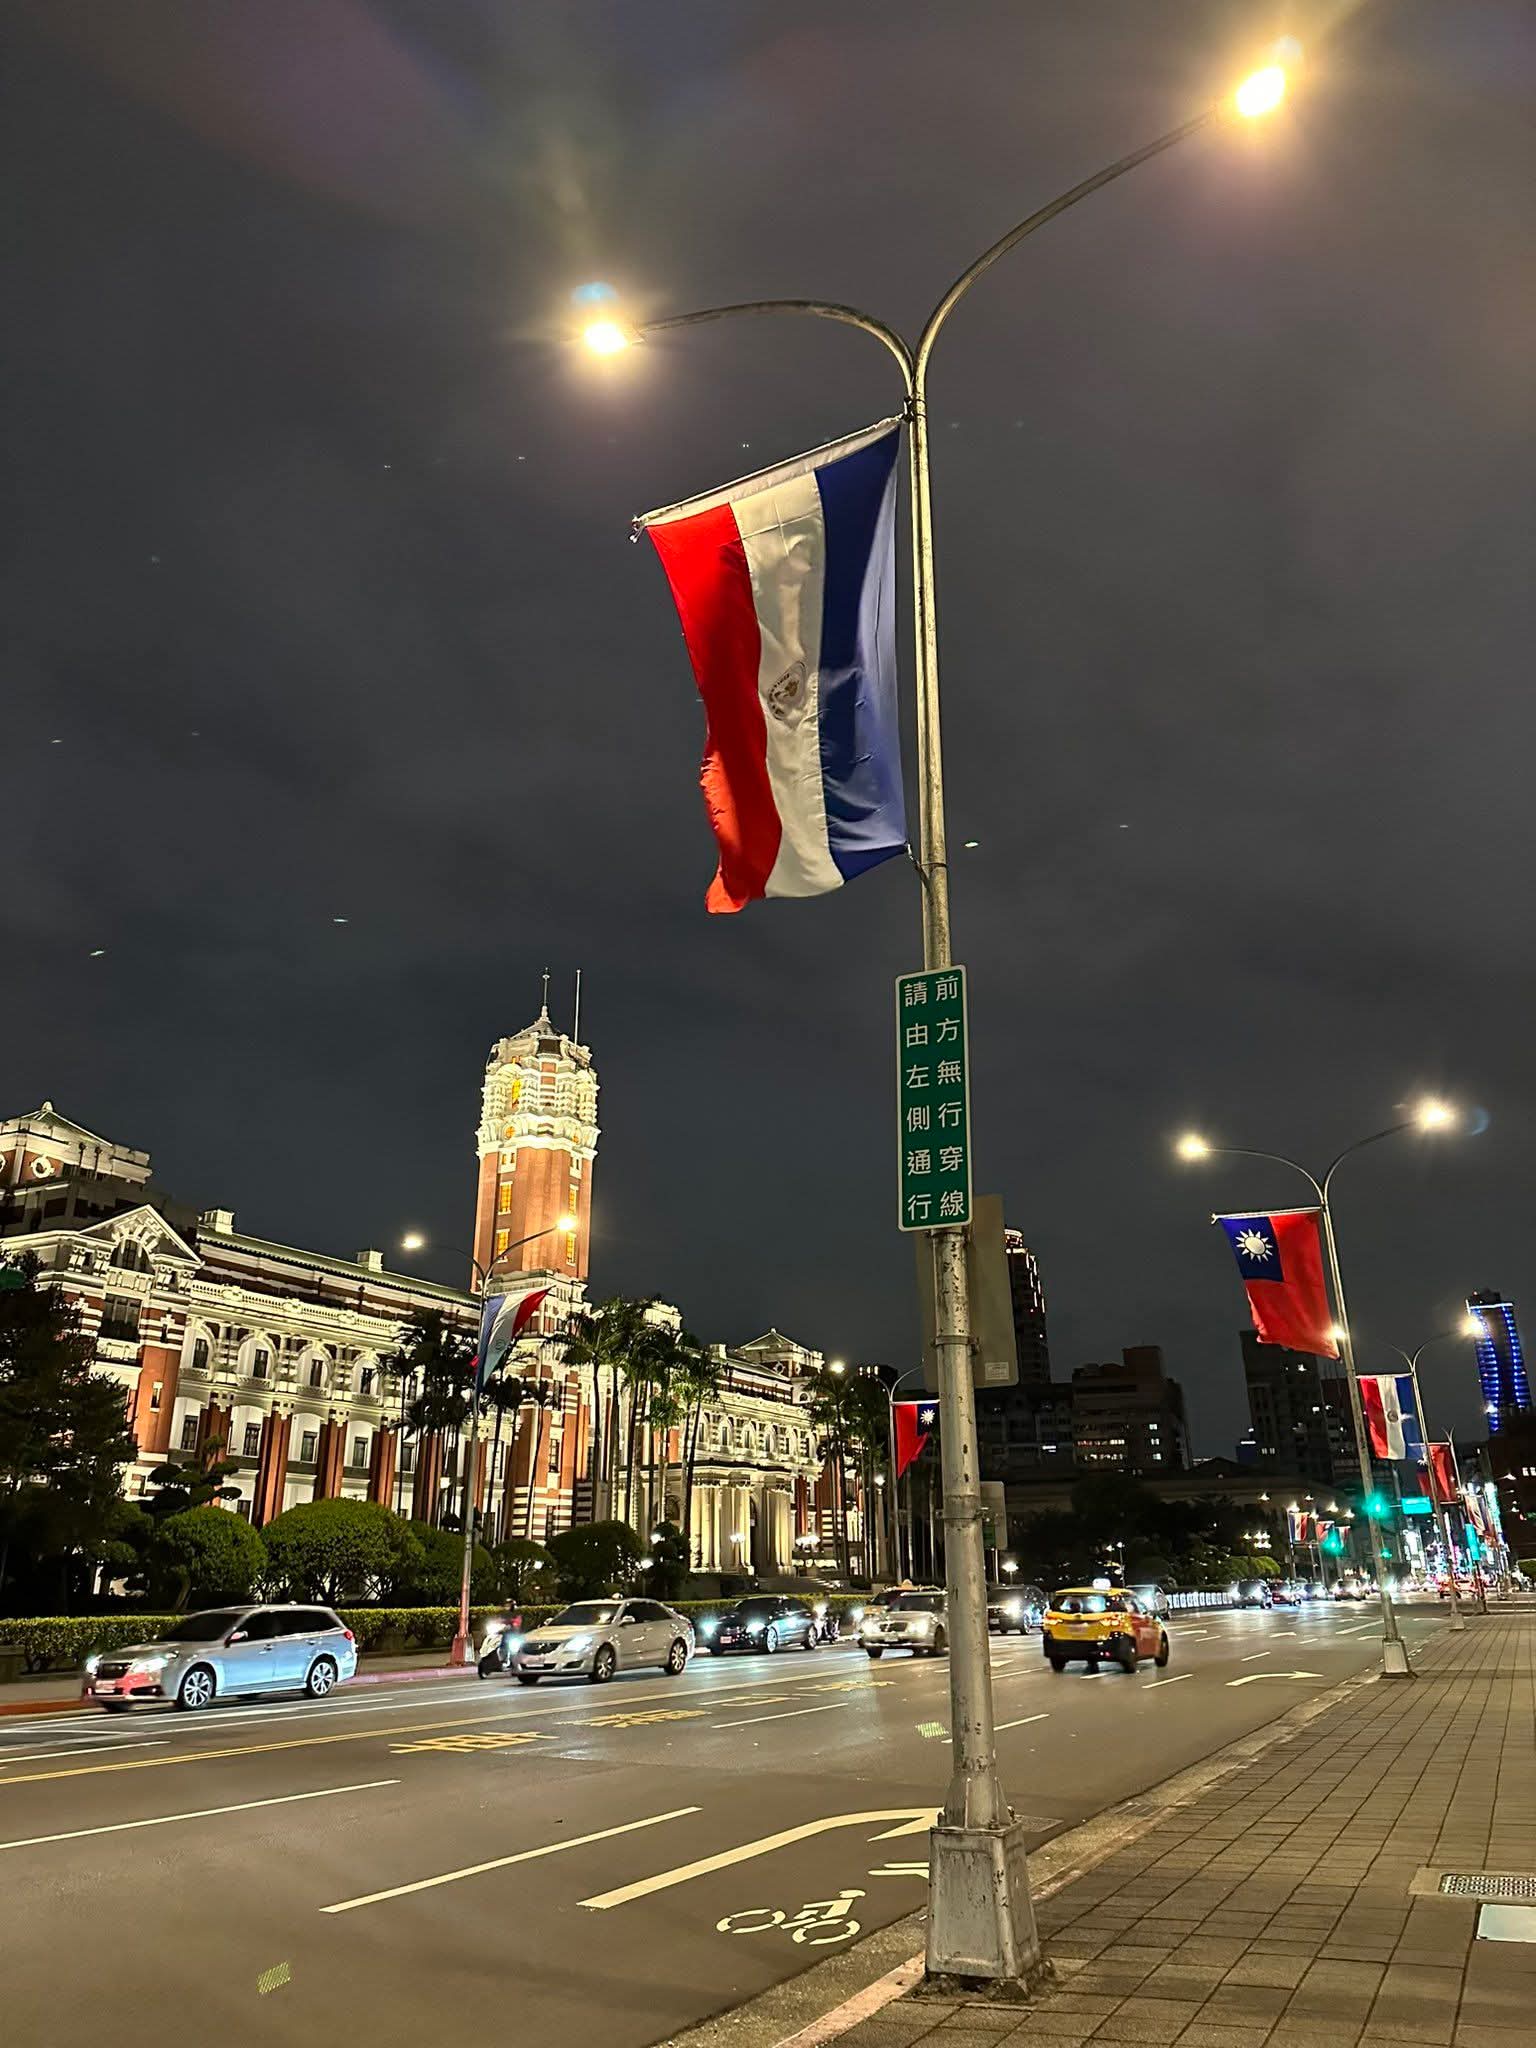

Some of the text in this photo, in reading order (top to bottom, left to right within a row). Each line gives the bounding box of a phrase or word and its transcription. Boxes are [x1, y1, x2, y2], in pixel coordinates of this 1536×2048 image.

[904, 981, 932, 1221] 請由左側通行
[935, 976, 965, 1217] 前方無行穿線
